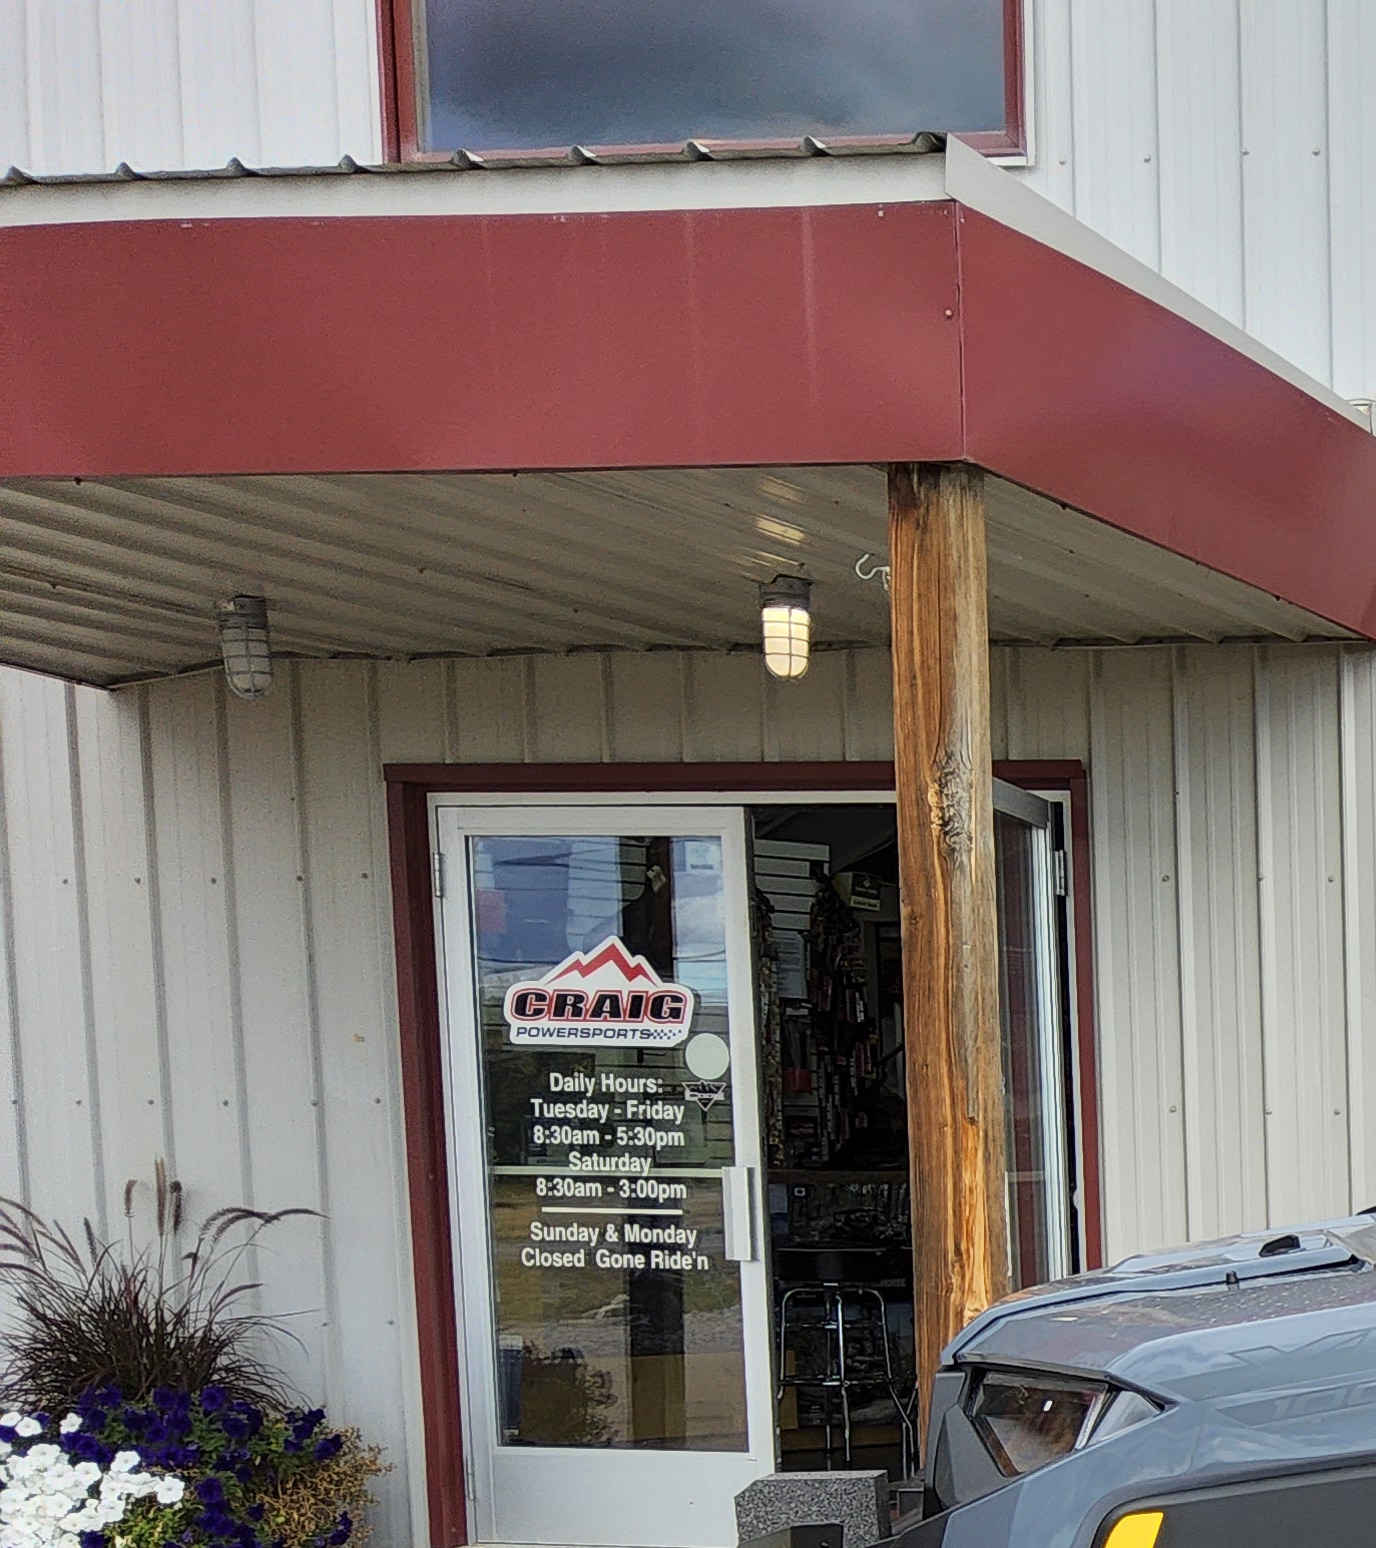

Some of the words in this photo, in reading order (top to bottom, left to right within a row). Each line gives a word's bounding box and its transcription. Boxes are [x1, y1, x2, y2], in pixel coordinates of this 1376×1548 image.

[511, 988, 687, 1024] CRAIG
[516, 1026, 651, 1040] POWERSPORTS
[550, 1072, 595, 1097] Daily
[601, 1073, 663, 1094] Hours:
[530, 1098, 609, 1123] Tuesday
[626, 1100, 685, 1125] Friday
[533, 1126, 600, 1145] 8:30am
[616, 1127, 685, 1151] 5:30pm
[568, 1151, 652, 1177] Saturday
[536, 1178, 602, 1197] 8:30am
[619, 1179, 687, 1204] 3:00pm
[530, 1222, 599, 1247] Sunday
[605, 1223, 619, 1243] &
[624, 1223, 697, 1249] Monday
[521, 1247, 586, 1267] Closed
[595, 1249, 646, 1269] Gone
[651, 1250, 710, 1271] Ride'n
